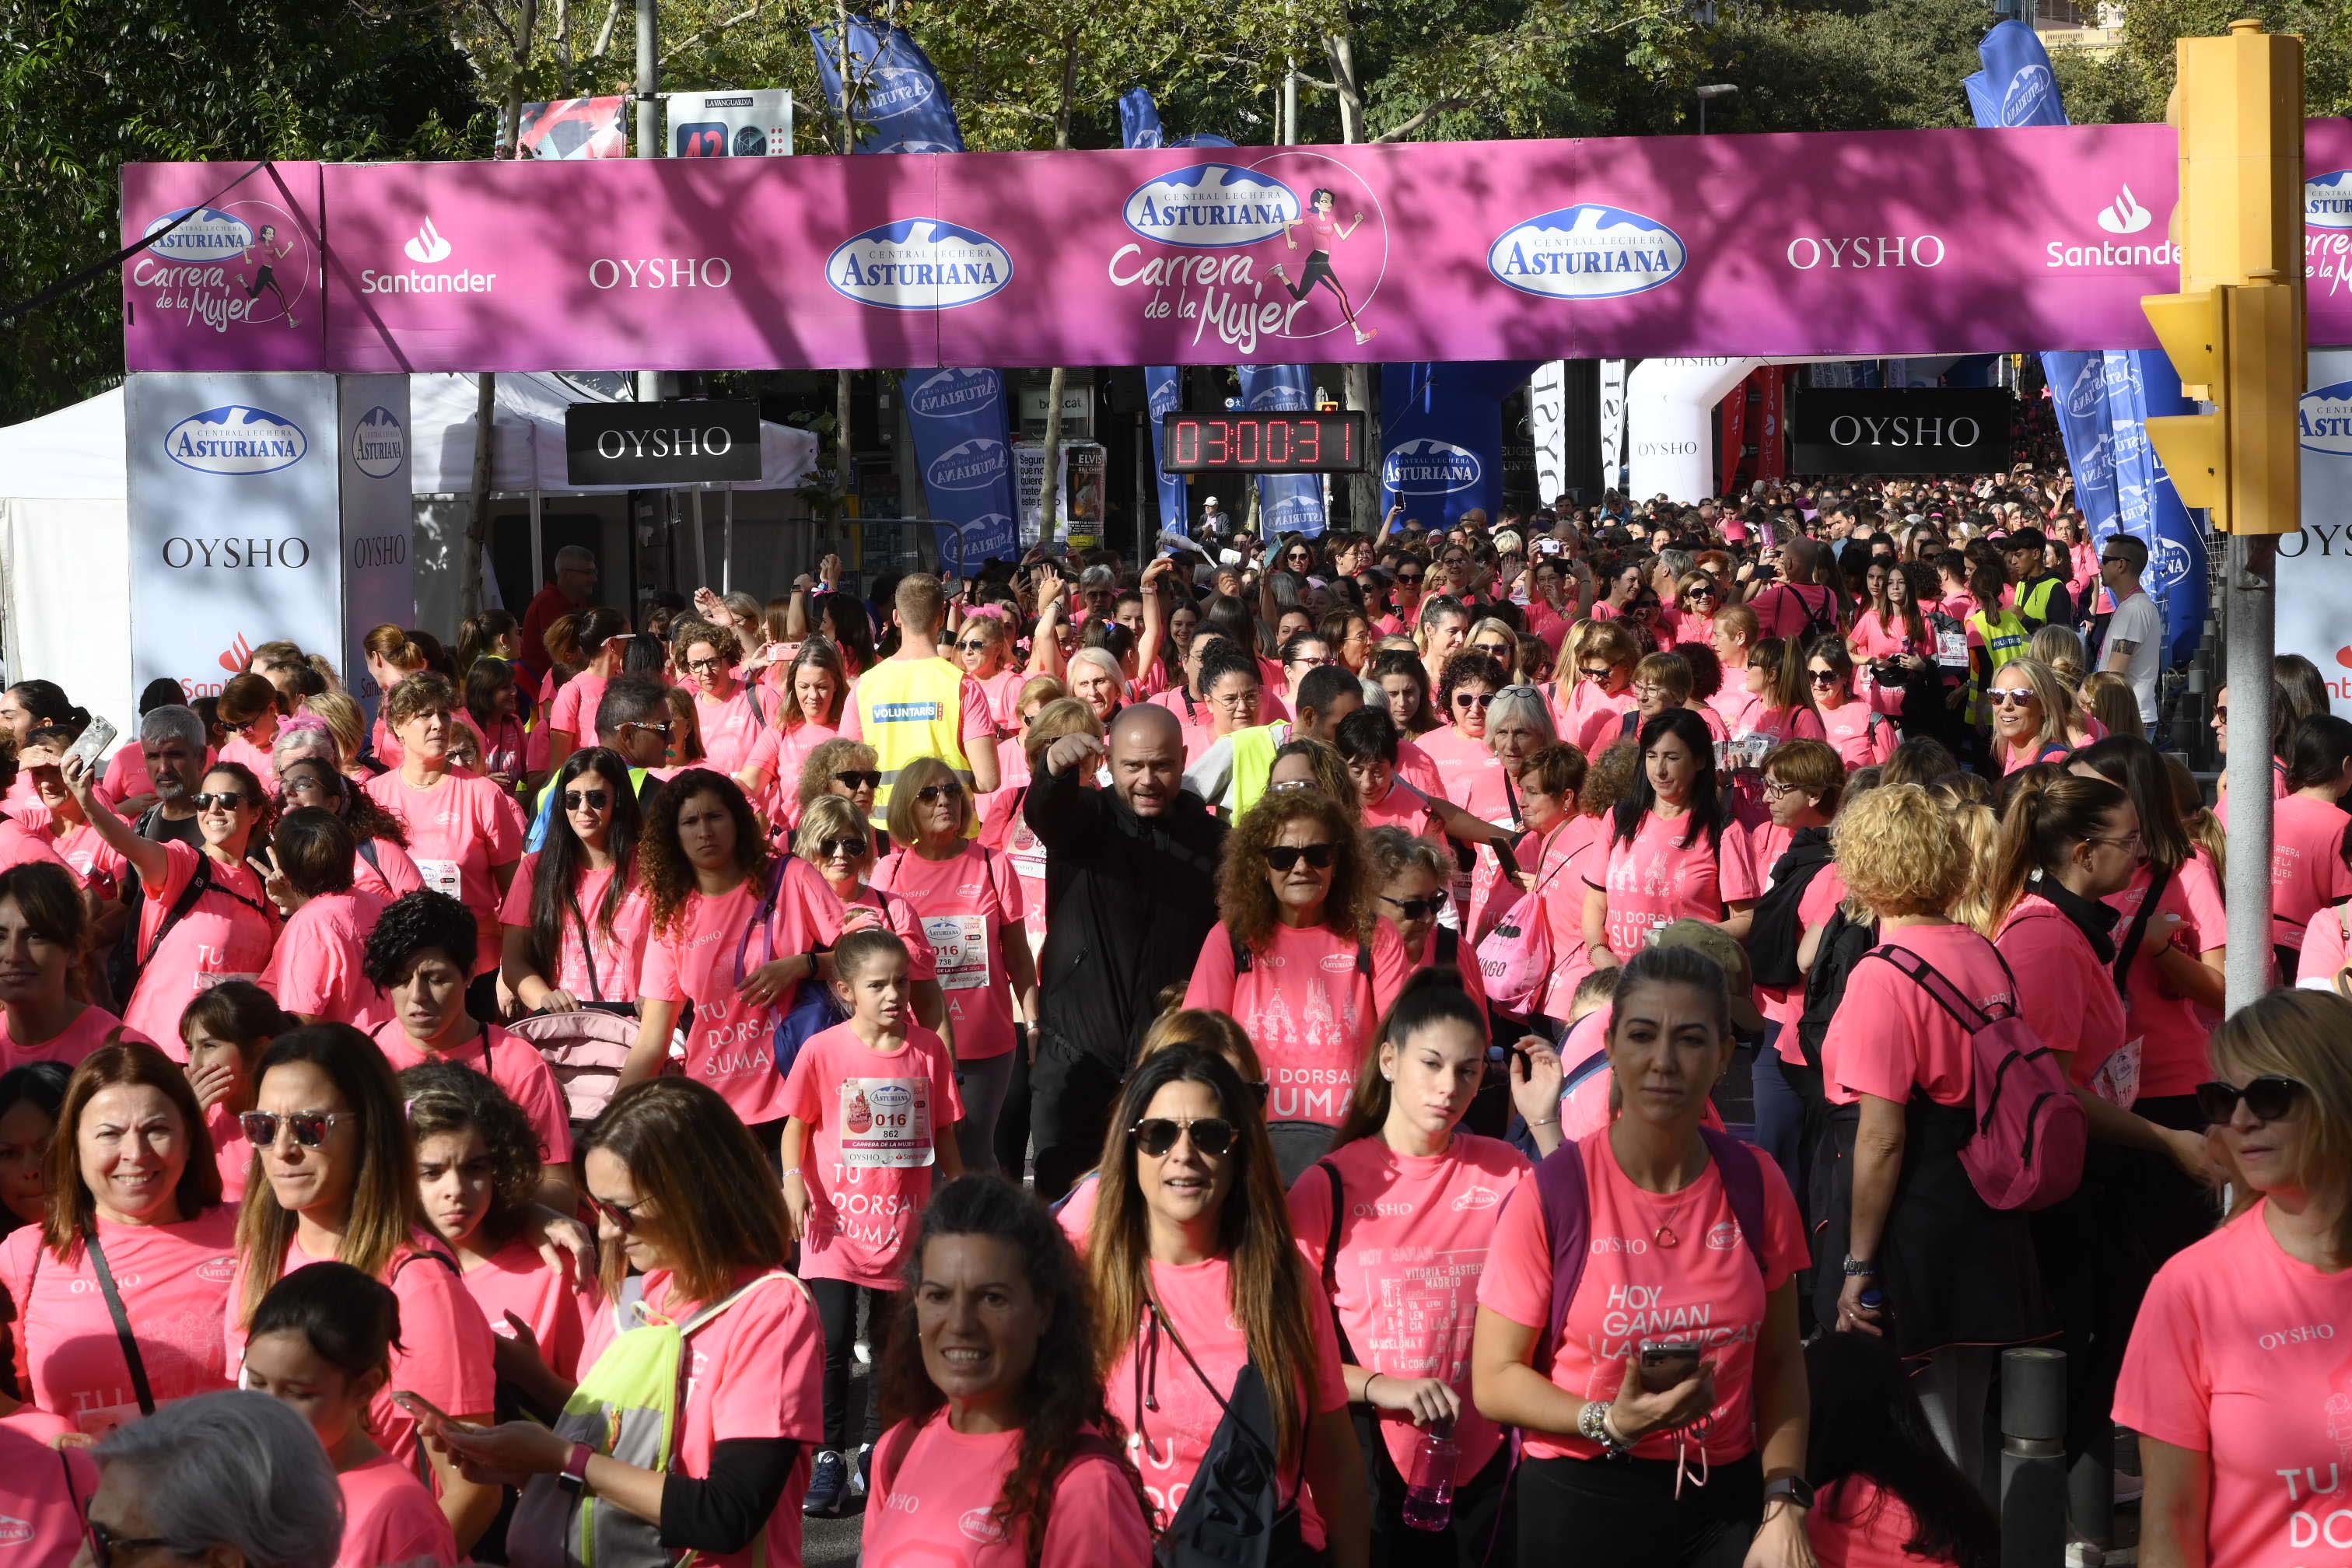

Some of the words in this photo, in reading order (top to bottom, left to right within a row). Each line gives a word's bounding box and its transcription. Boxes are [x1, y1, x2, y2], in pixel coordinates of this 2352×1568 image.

[1164, 191, 1219, 202] CENTRAL
[1225, 190, 1282, 201] LECHERA
[1137, 196, 1286, 227] ASTURIANA
[152, 227, 245, 248] ASTURIANA
[1534, 237, 1593, 247] CENTRAL
[1601, 235, 1665, 246] LECHERA
[868, 248, 928, 259] CENTRAL
[934, 247, 992, 258] LECHERA
[1503, 240, 1671, 275] ASTURIANA
[1787, 235, 1944, 269] OYSHO
[2046, 240, 2181, 268] Santande
[133, 258, 225, 288] Carrera
[589, 257, 732, 289] OYSHO
[842, 251, 999, 286] ASTURIANA
[1108, 243, 1255, 287] Carrera
[361, 268, 496, 294] Santander
[156, 289, 173, 309] de
[177, 289, 189, 310] la
[186, 282, 261, 333] Mujer
[1144, 290, 1171, 320] de
[1178, 289, 1197, 319] la
[1192, 281, 1310, 355] Mujer
[597, 426, 732, 459] OYSHO
[1176, 421, 1350, 464] 03:00:31
[1830, 415, 1980, 448] OYSHO
[176, 431, 297, 457] ASTURIANA
[357, 433, 401, 460] ASTURIANA
[1638, 441, 1698, 457] OYSHO
[1078, 453, 1102, 464] ELVIS
[1385, 460, 1474, 482] ASTURIANA
[1021, 497, 1035, 506] este
[162, 537, 310, 569] OYSHO
[354, 534, 405, 569] OYSHO
[873, 705, 935, 719] VOLUNTARIS
[687, 929, 723, 951] OYSHO
[928, 928, 959, 937] ASTURIANA
[197, 944, 224, 965] TU
[698, 999, 728, 1023] TU
[705, 1047, 770, 1076] SUMA
[873, 1094, 908, 1102] ASTURIANA
[875, 1114, 907, 1126] 016
[833, 1163, 861, 1184] TU
[832, 1192, 926, 1216] DORSAL
[1353, 1203, 1413, 1216] OYSHO
[833, 1214, 901, 1245] SUMA
[1591, 1238, 1647, 1255] OYSHO
[1405, 1268, 1440, 1279] VITORIA
[1425, 1276, 1461, 1289] MADRID
[1407, 1300, 1419, 1310] VA
[1606, 1284, 1662, 1309] HOY
[1409, 1311, 1424, 1320] LEN
[1409, 1322, 1423, 1332] CIA
[1602, 1304, 1710, 1337] GANAN
[1369, 1338, 1416, 1349] BARCELONA
[2259, 1323, 2334, 1351] OYSHO
[2276, 1462, 2339, 1501] TU
